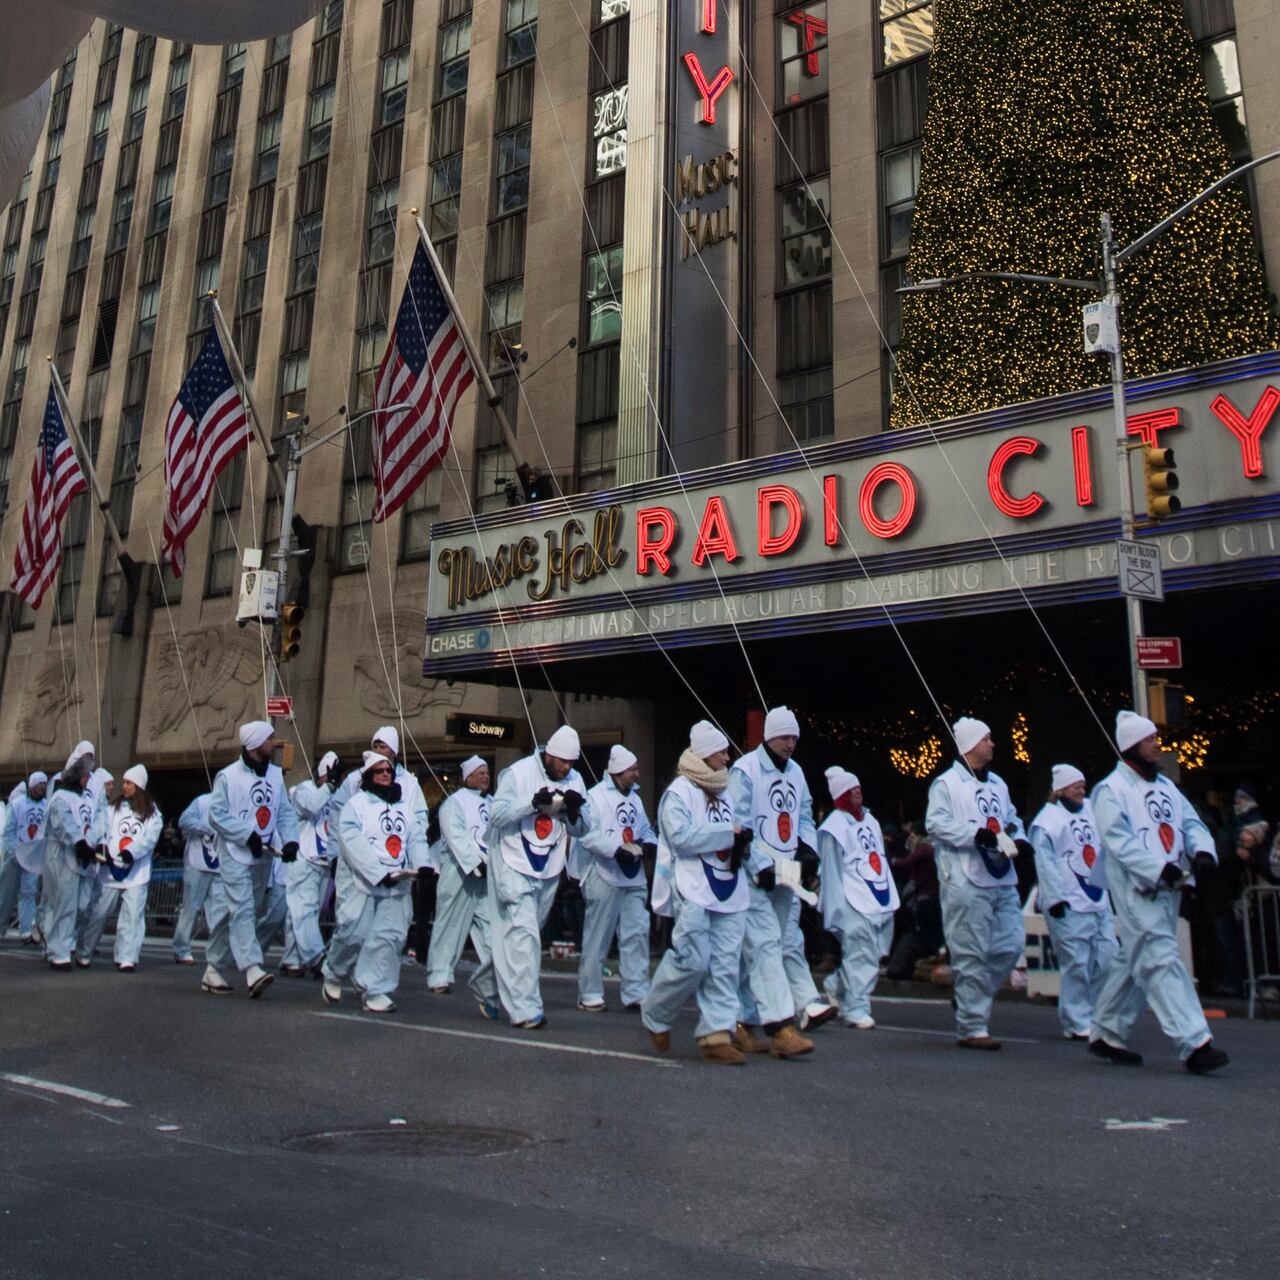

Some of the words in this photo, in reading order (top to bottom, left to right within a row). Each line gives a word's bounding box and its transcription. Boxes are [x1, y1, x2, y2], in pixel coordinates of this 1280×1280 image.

[676, 152, 735, 206] MUSIC
[680, 206, 735, 261] HALL
[437, 535, 539, 610] Music
[527, 504, 626, 601] Hall
[636, 460, 917, 576] RADIO
[517, 608, 633, 646] CHRISTMAS
[648, 585, 826, 630] SPECTACULAR
[842, 562, 981, 608] STARRING
[1006, 551, 1061, 584] THE
[431, 632, 476, 653] CHASE
[468, 722, 505, 738] Subway
